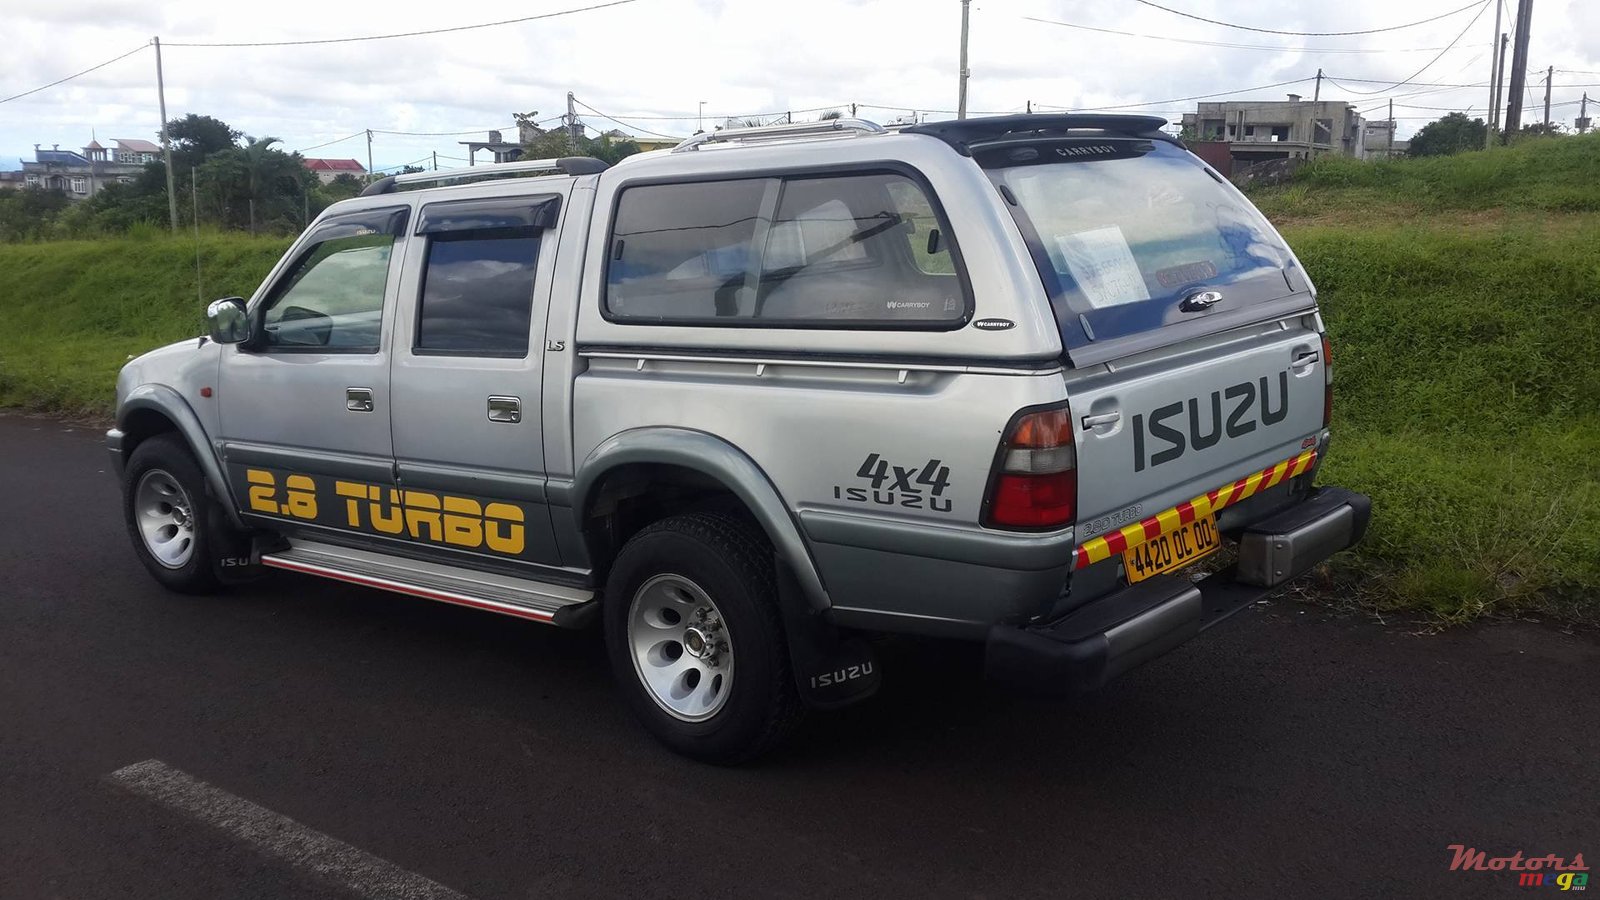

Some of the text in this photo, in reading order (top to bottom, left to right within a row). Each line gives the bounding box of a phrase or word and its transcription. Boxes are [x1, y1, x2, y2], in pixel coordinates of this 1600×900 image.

[1055, 145, 1117, 157] CARRYBOY
[547, 340, 565, 351] LS
[1132, 371, 1289, 473] ISUZU
[856, 453, 951, 497] 4x4
[247, 469, 525, 554] 2.8 TURBO
[834, 486, 952, 512] ISUZU
[221, 558, 249, 567] ISU
[1134, 535, 1172, 577] 4420
[811, 661, 873, 689] ISUZU
